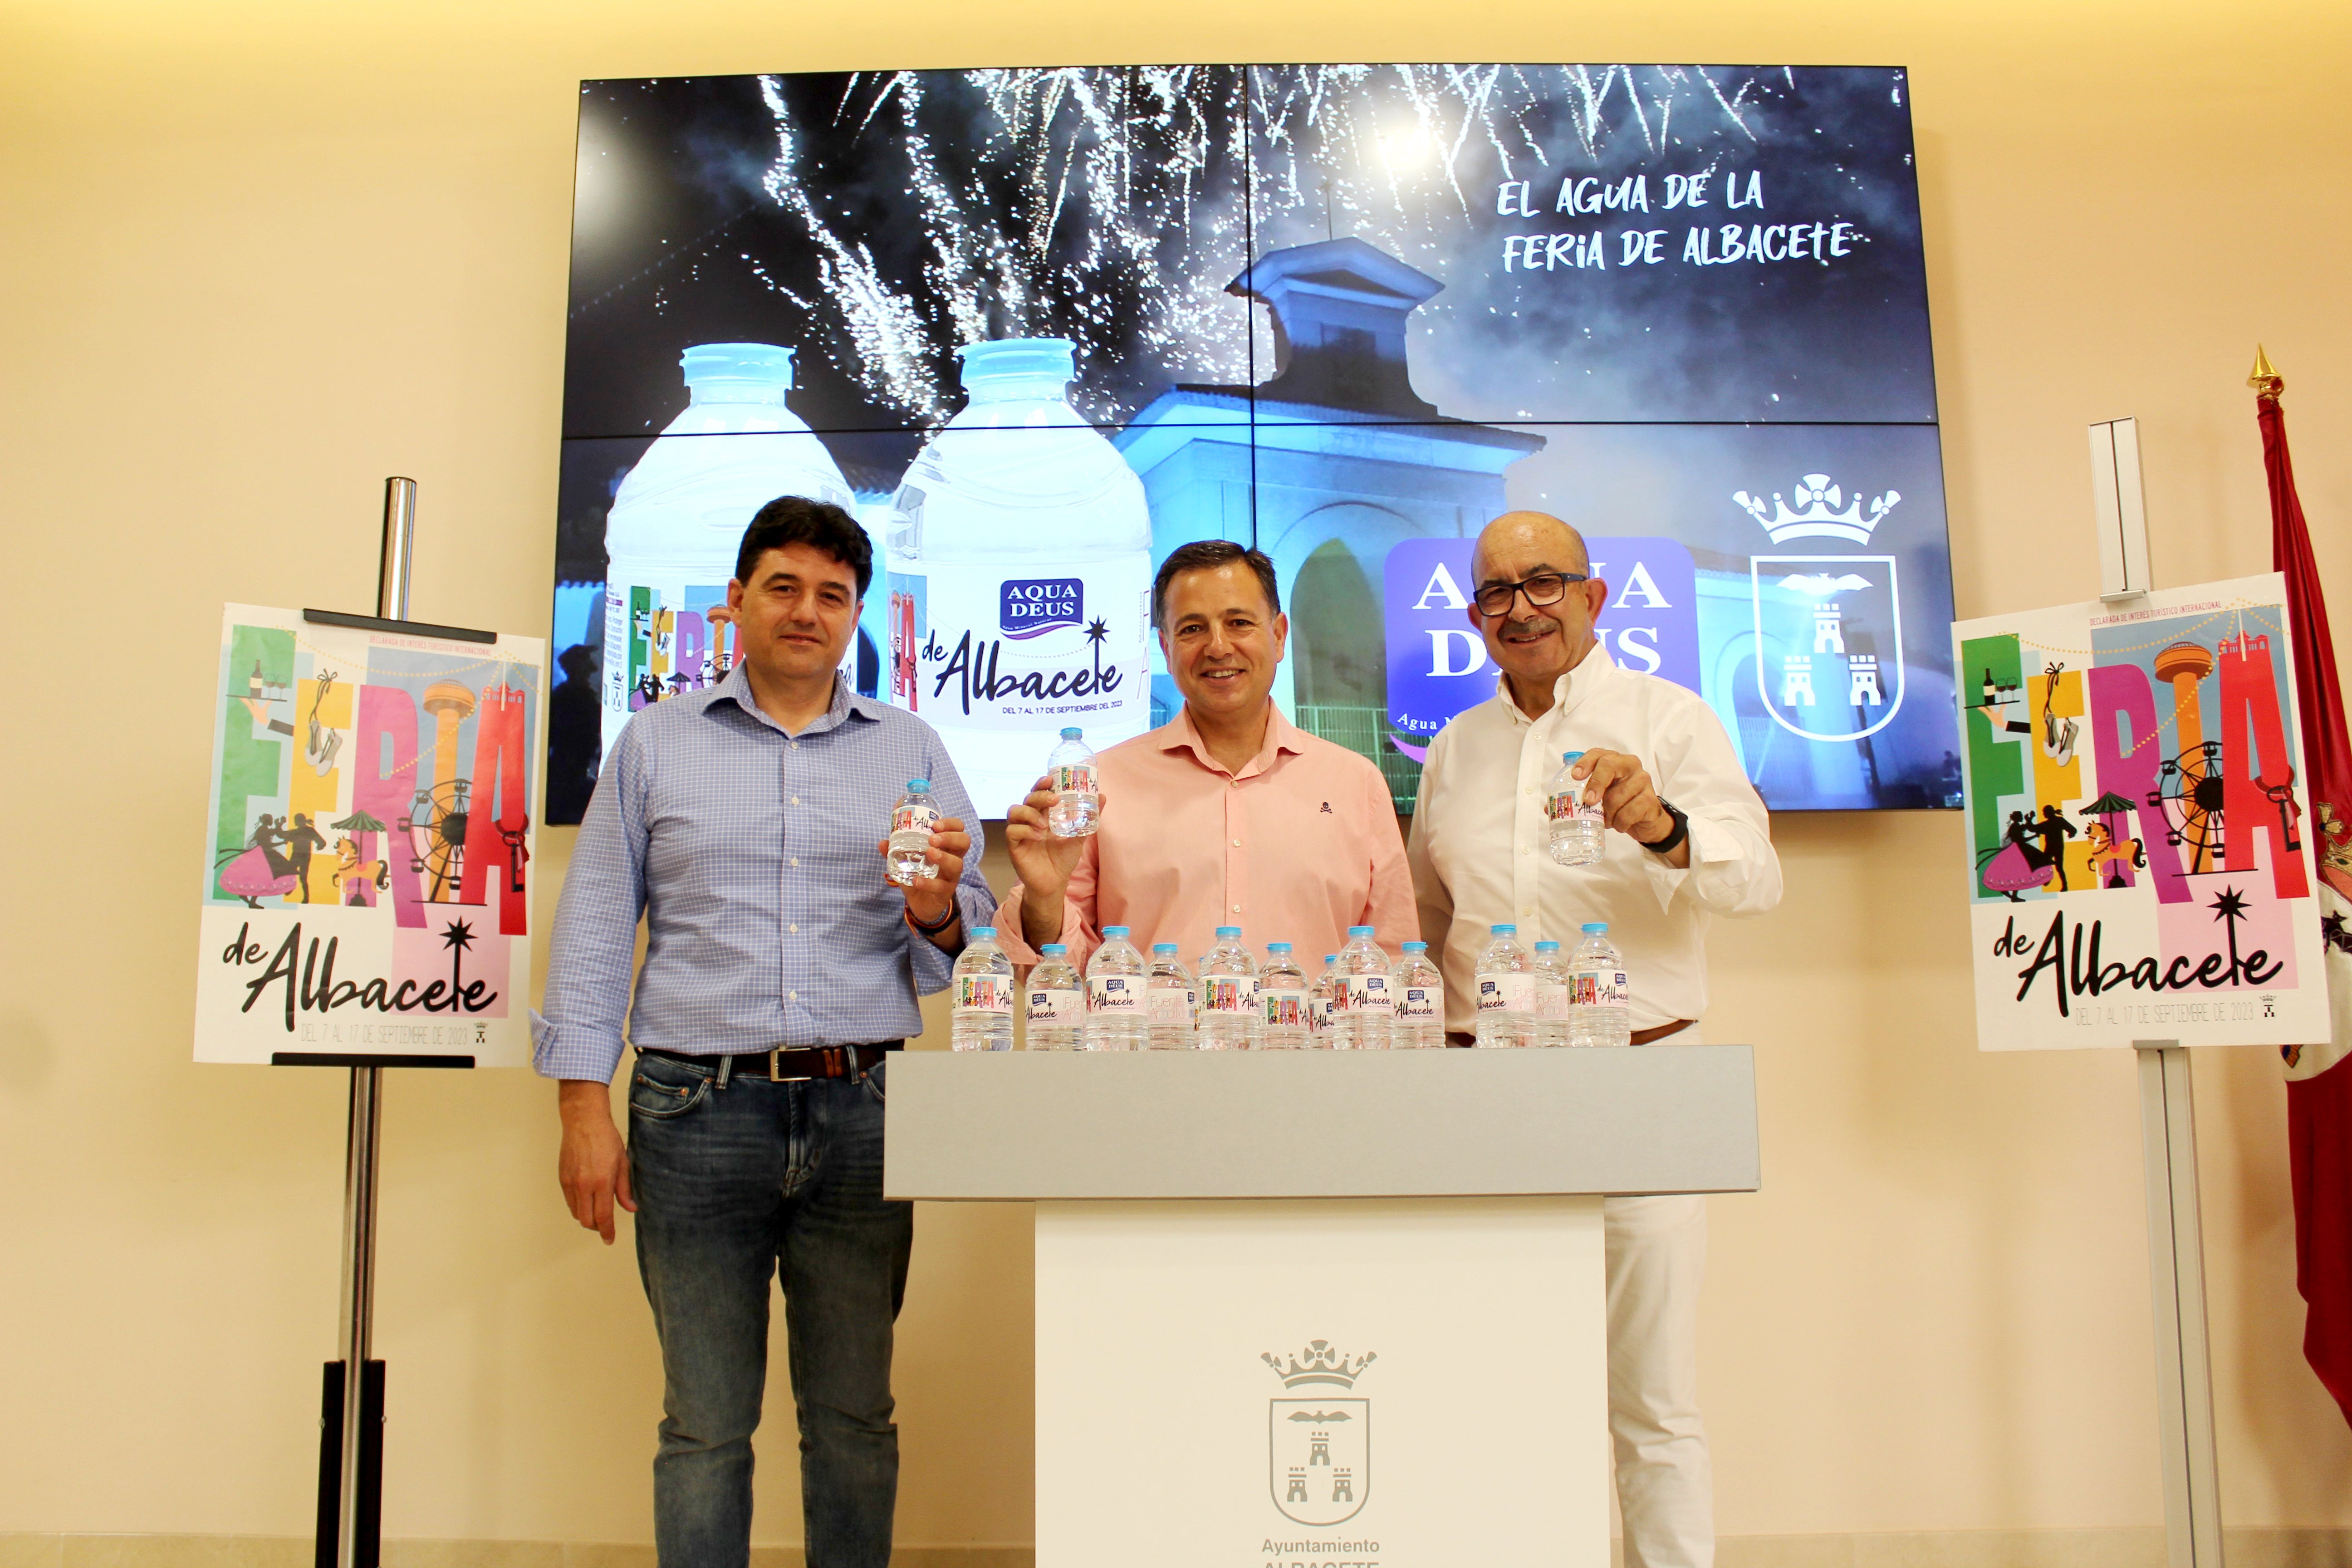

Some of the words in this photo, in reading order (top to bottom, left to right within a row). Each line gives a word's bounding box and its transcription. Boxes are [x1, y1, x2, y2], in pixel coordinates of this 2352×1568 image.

[1497, 180, 1540, 218] EL
[1556, 175, 1649, 216] AGUA
[1662, 173, 1710, 211] DE
[1727, 170, 1764, 210] LA
[1618, 229, 1668, 266] DE
[1007, 584, 1078, 602] AQUA
[1411, 561, 1673, 610] AA
[1010, 601, 1074, 617] DEUS
[2089, 615, 2119, 626] DECLARADA
[2121, 613, 2127, 622] DE
[2179, 601, 2222, 613] INTERNACIONAL
[922, 629, 948, 662] de
[1425, 626, 1662, 677] DS
[934, 615, 1123, 715] Albacete
[1056, 703, 1098, 713] SEPTIEMBRE
[1397, 713, 1438, 731] Agua
[212, 624, 527, 936] FERIA
[1961, 632, 2310, 904] FERIA
[223, 922, 270, 966] de
[1994, 915, 2035, 958] de
[2016, 884, 2284, 1018] Albacete
[241, 915, 498, 1032] Albacete
[1093, 988, 1135, 1011] Albacete
[1349, 990, 1356, 998] de
[1352, 988, 1391, 1009] Albacete
[1597, 984, 1605, 992] de
[1395, 998, 1434, 1019] Albacete
[2075, 1007, 2092, 1025] DEL
[2097, 1007, 2102, 1025] 7
[2107, 1006, 2118, 1024] AL
[2124, 1005, 2133, 1024] 17
[2137, 1005, 2150, 1024] DE
[2154, 1003, 2209, 1023] SEPTIEMBRE
[2214, 1002, 2225, 1021] DE
[2230, 1001, 2254, 1021] 2023
[301, 1023, 317, 1042] DEL
[323, 1024, 328, 1041] 7
[332, 1024, 343, 1042] AL
[350, 1024, 359, 1042] 17
[363, 1025, 374, 1043] DE
[378, 1025, 428, 1044] SEPTIEMBRE
[432, 1026, 443, 1045] DE
[447, 1027, 467, 1045] 2023
[1262, 1536, 1380, 1556] Ayuntamiento
